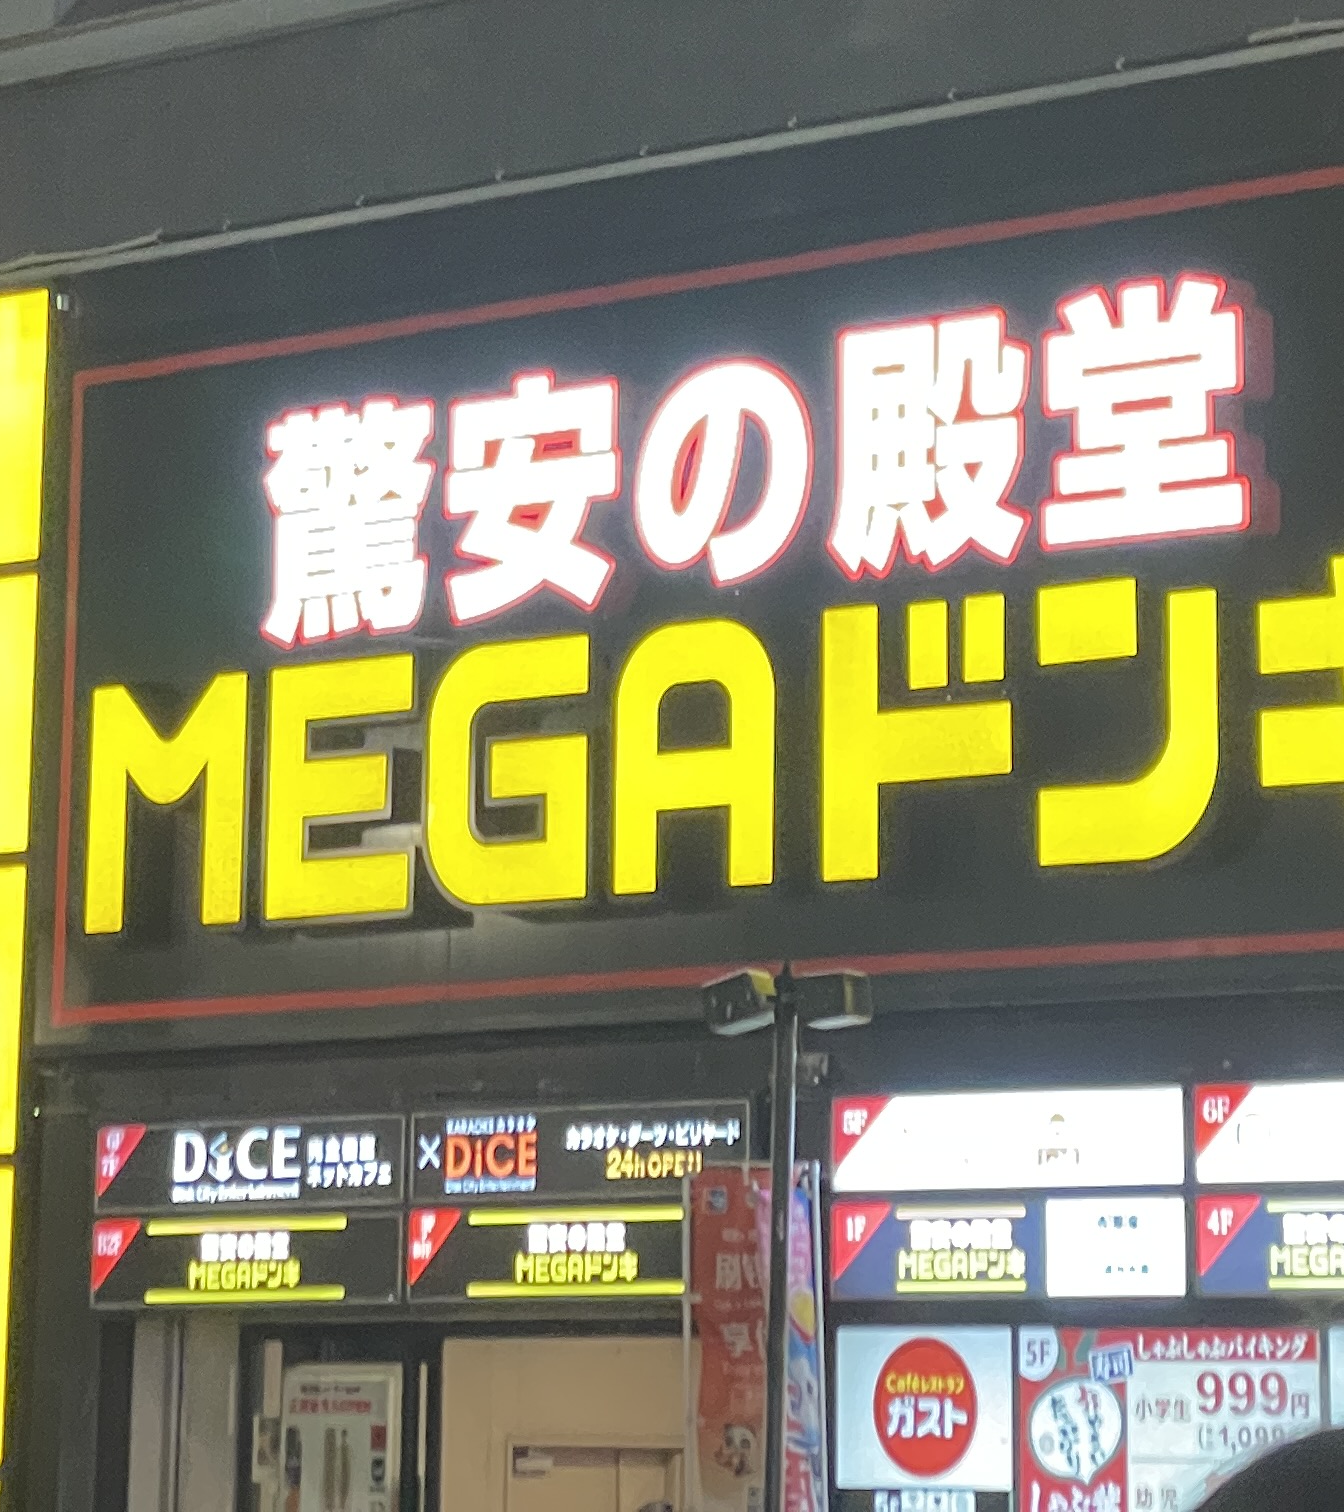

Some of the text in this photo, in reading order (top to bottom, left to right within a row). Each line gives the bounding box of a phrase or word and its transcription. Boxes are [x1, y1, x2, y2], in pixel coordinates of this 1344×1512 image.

[261, 273, 1252, 648] 驚安の殿堂
[1025, 1338, 1051, 1367] 5F
[1136, 1333, 1310, 1361] しゃぶしゃぶバイキング
[1196, 1370, 1310, 1419] 999円
[886, 1396, 968, 1439] ガスト
